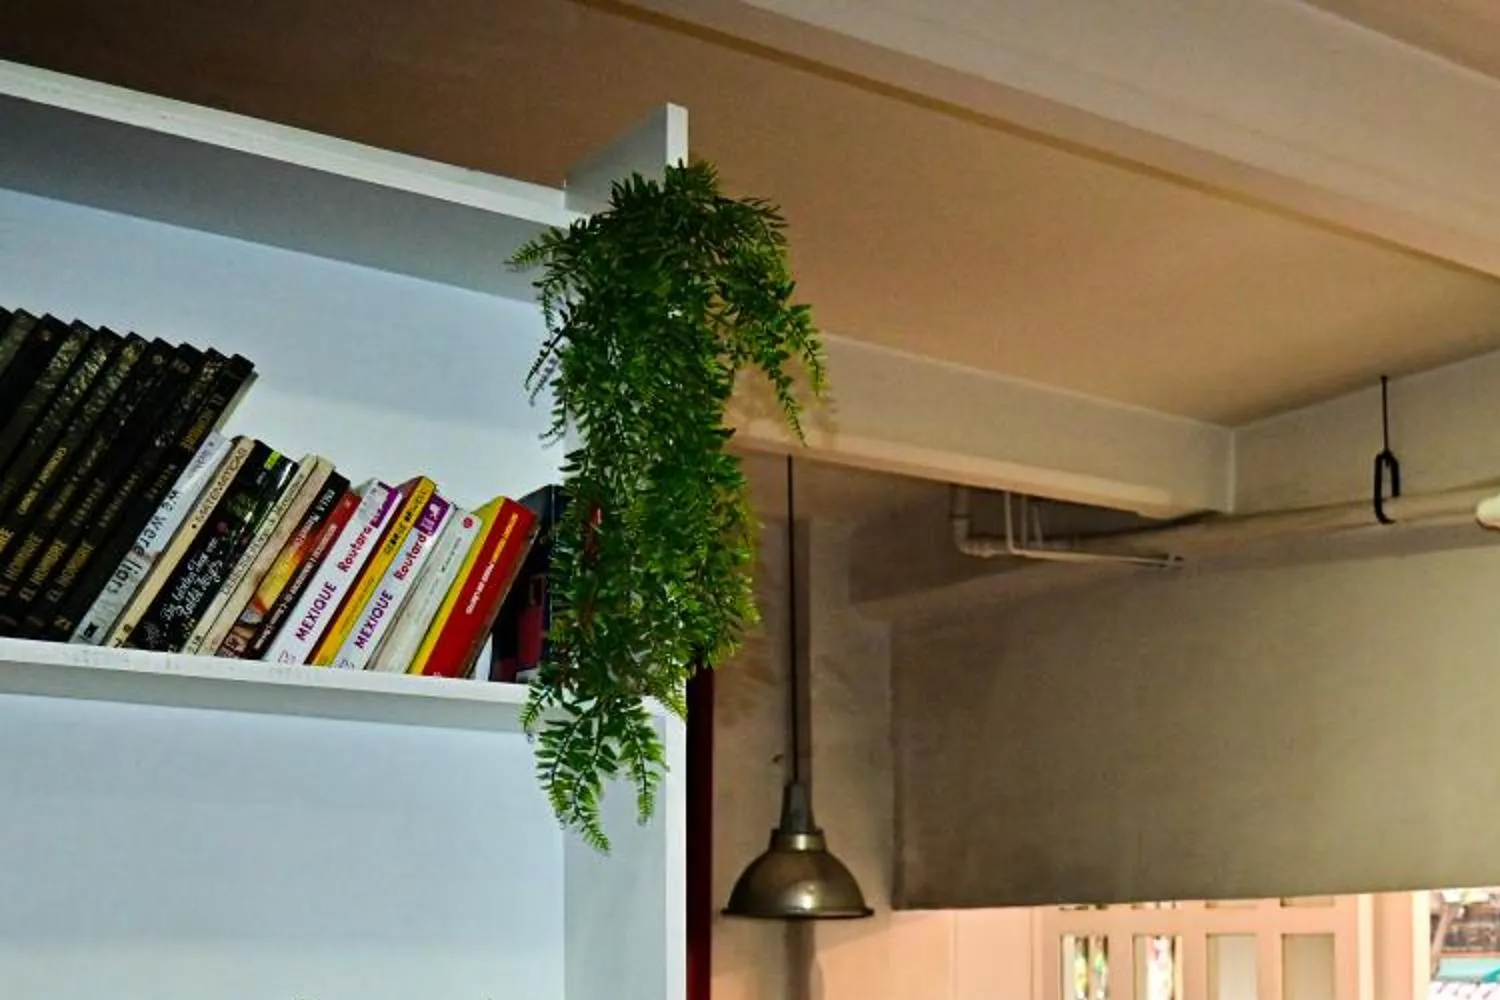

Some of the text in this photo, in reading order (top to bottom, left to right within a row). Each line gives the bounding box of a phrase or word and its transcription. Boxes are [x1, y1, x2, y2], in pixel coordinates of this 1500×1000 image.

[161, 489, 183, 511] we
[134, 515, 167, 555] were
[106, 556, 145, 594] liars
[354, 532, 428, 649] MEXIQUE Routard
[295, 580, 337, 641] MEXIQUE
